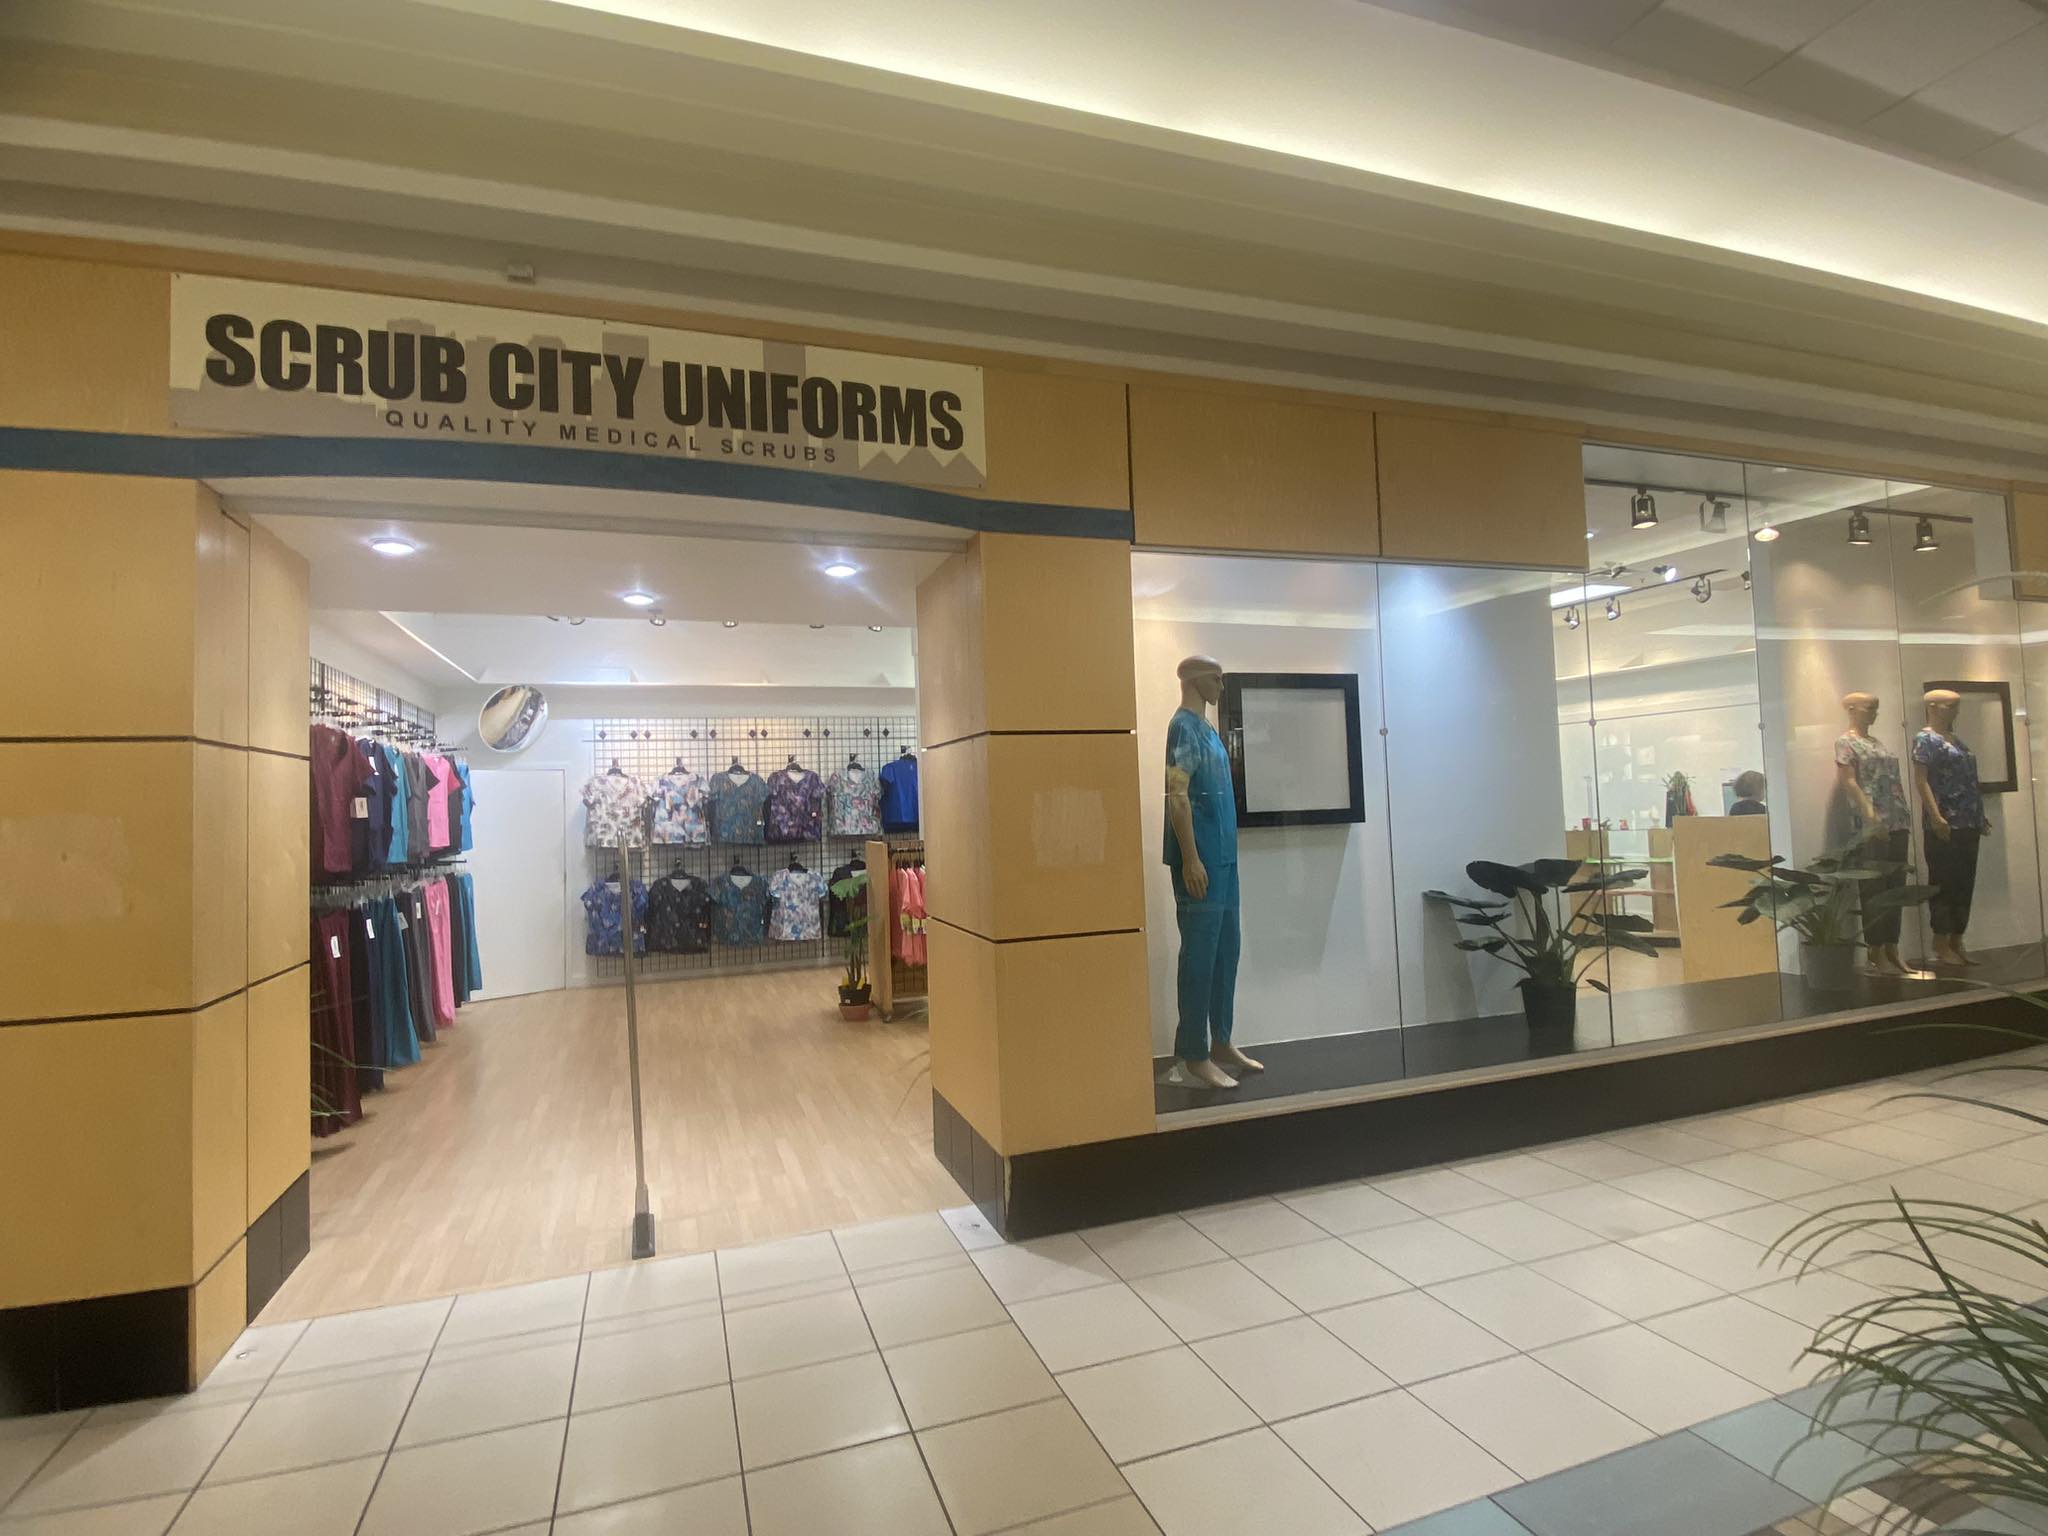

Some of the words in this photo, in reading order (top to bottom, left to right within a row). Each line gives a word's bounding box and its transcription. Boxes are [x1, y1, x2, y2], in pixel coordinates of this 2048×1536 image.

[205, 314, 467, 403] SCRUB
[489, 343, 644, 420] CITY
[662, 361, 964, 450] UNIFORMS
[386, 410, 538, 437] QUALITY
[559, 424, 701, 452] MEDICAL
[721, 438, 836, 463] SCRUBS
